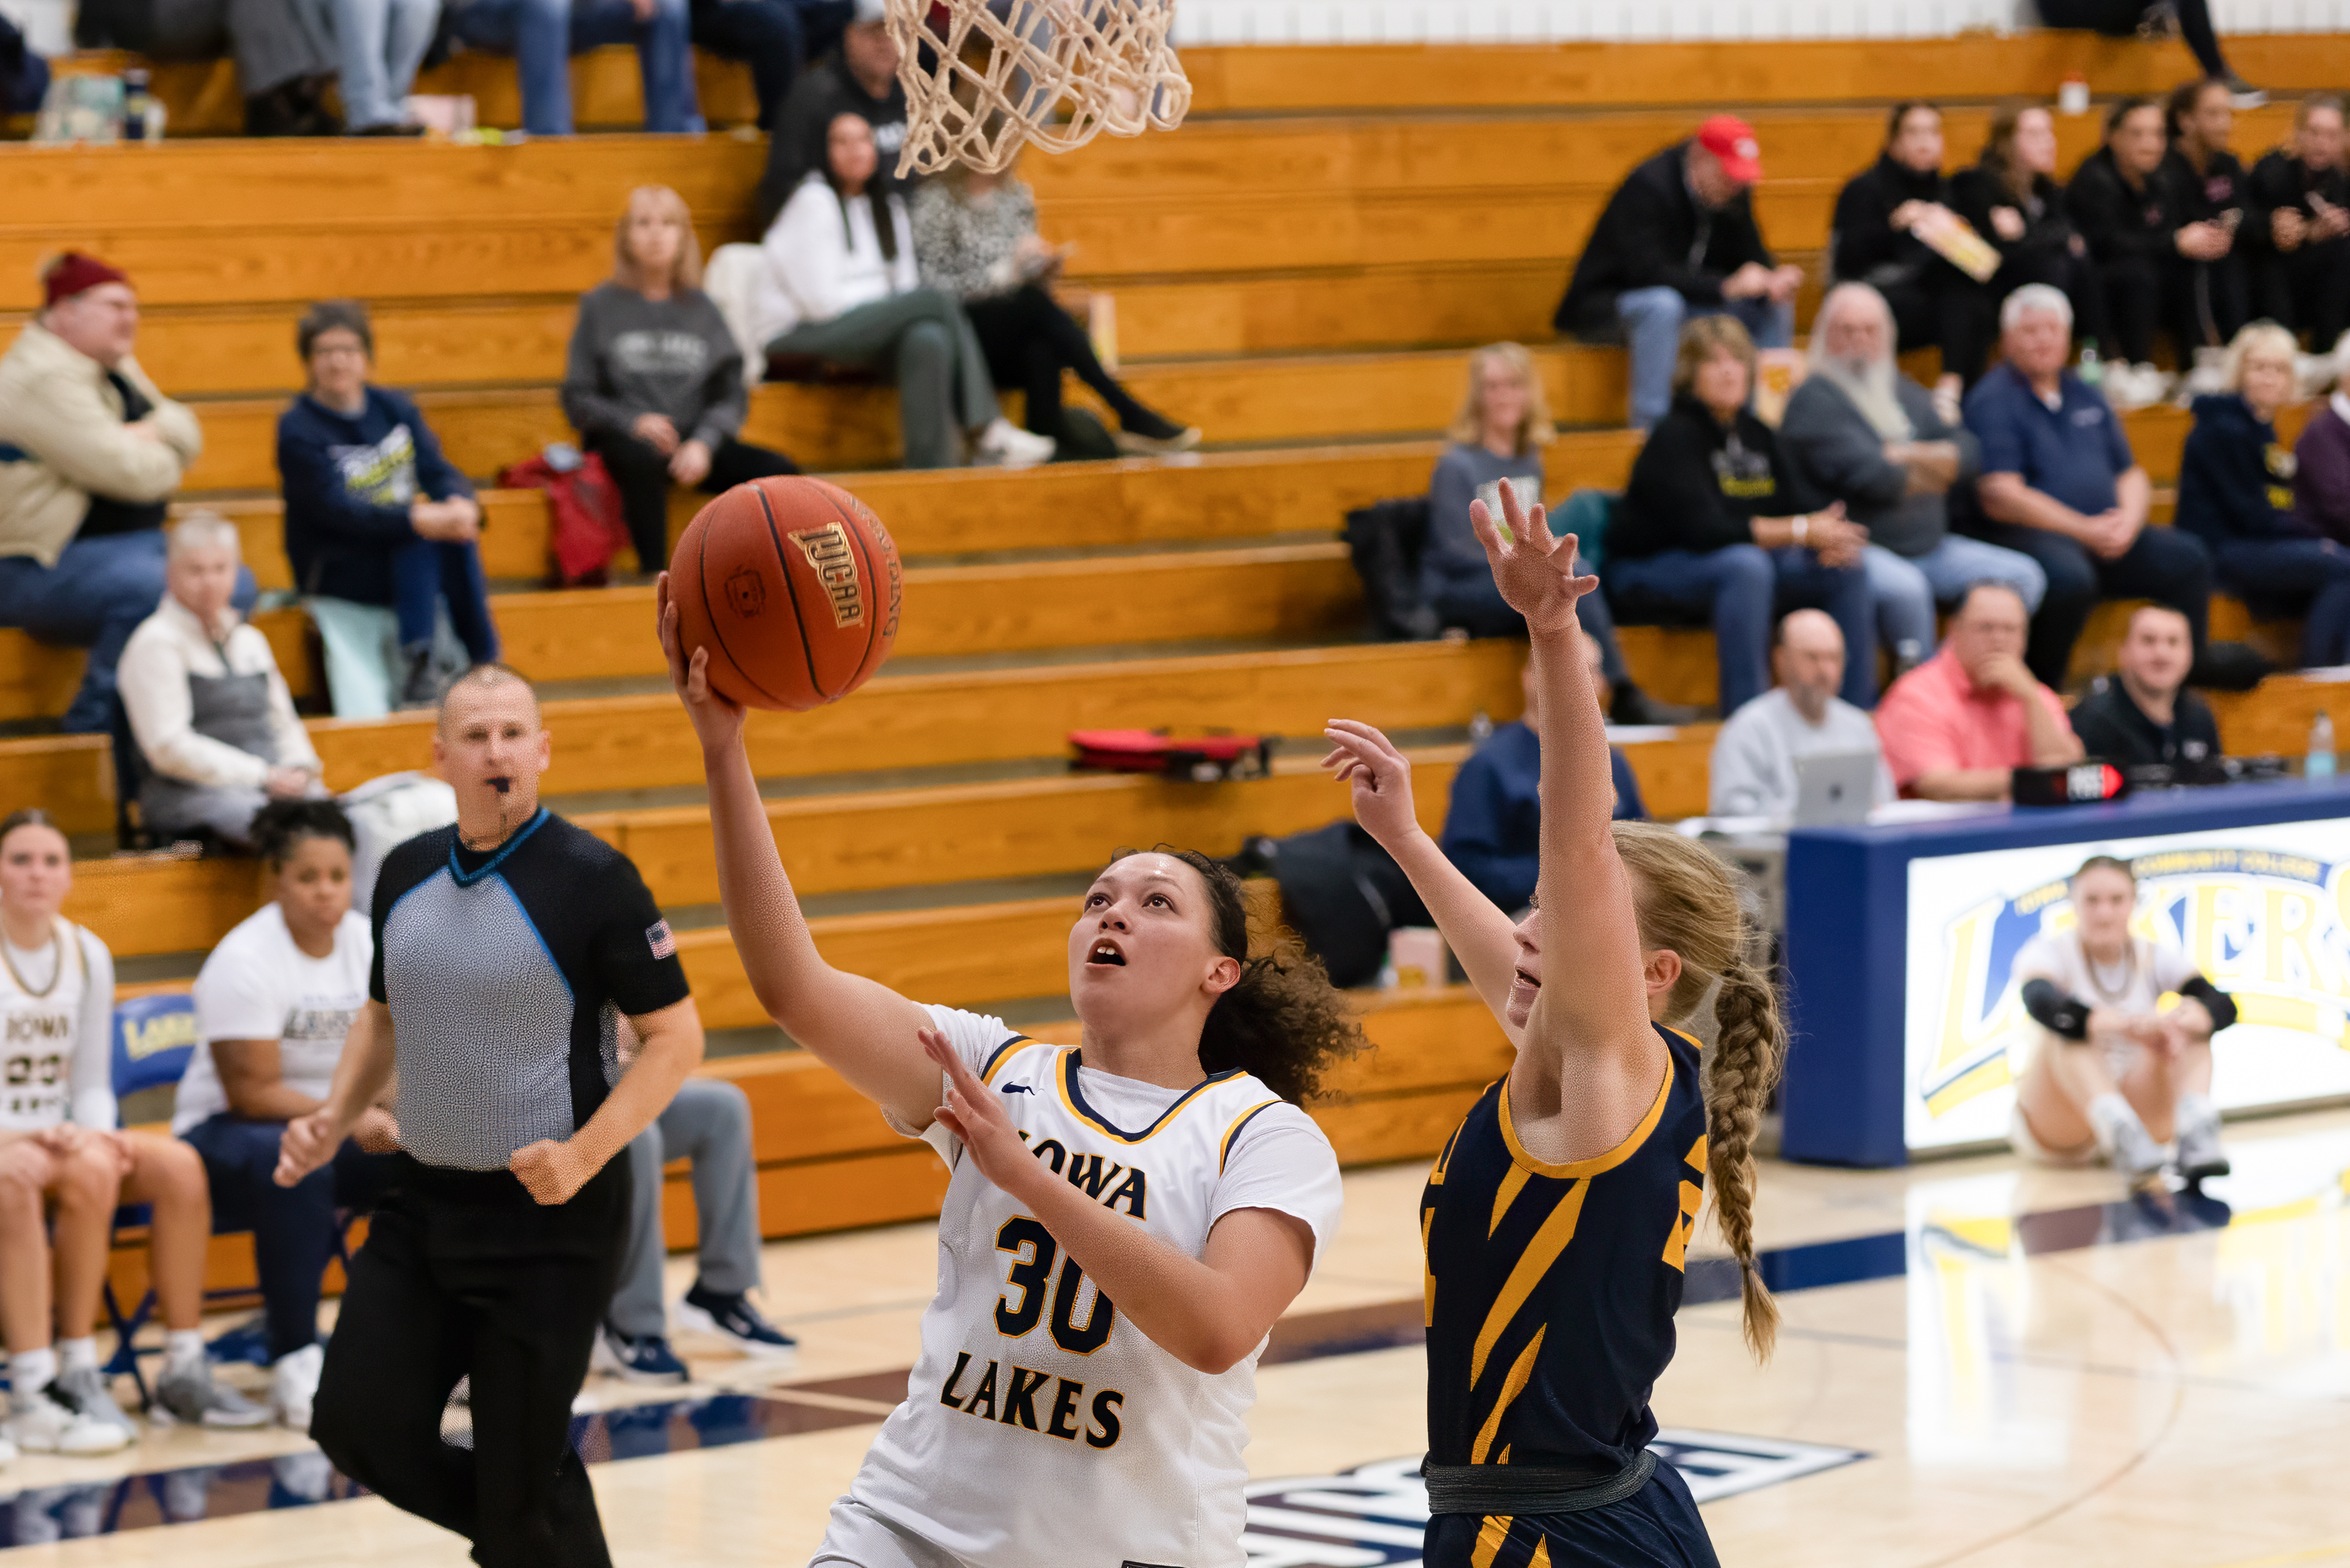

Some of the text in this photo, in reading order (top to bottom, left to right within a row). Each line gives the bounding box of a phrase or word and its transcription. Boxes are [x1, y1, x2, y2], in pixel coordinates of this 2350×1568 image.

[790, 522, 864, 628] NJCAA
[1018, 1129, 1147, 1221] OWA
[993, 1214, 1115, 1357] 30
[939, 1350, 1126, 1451] LAKES
